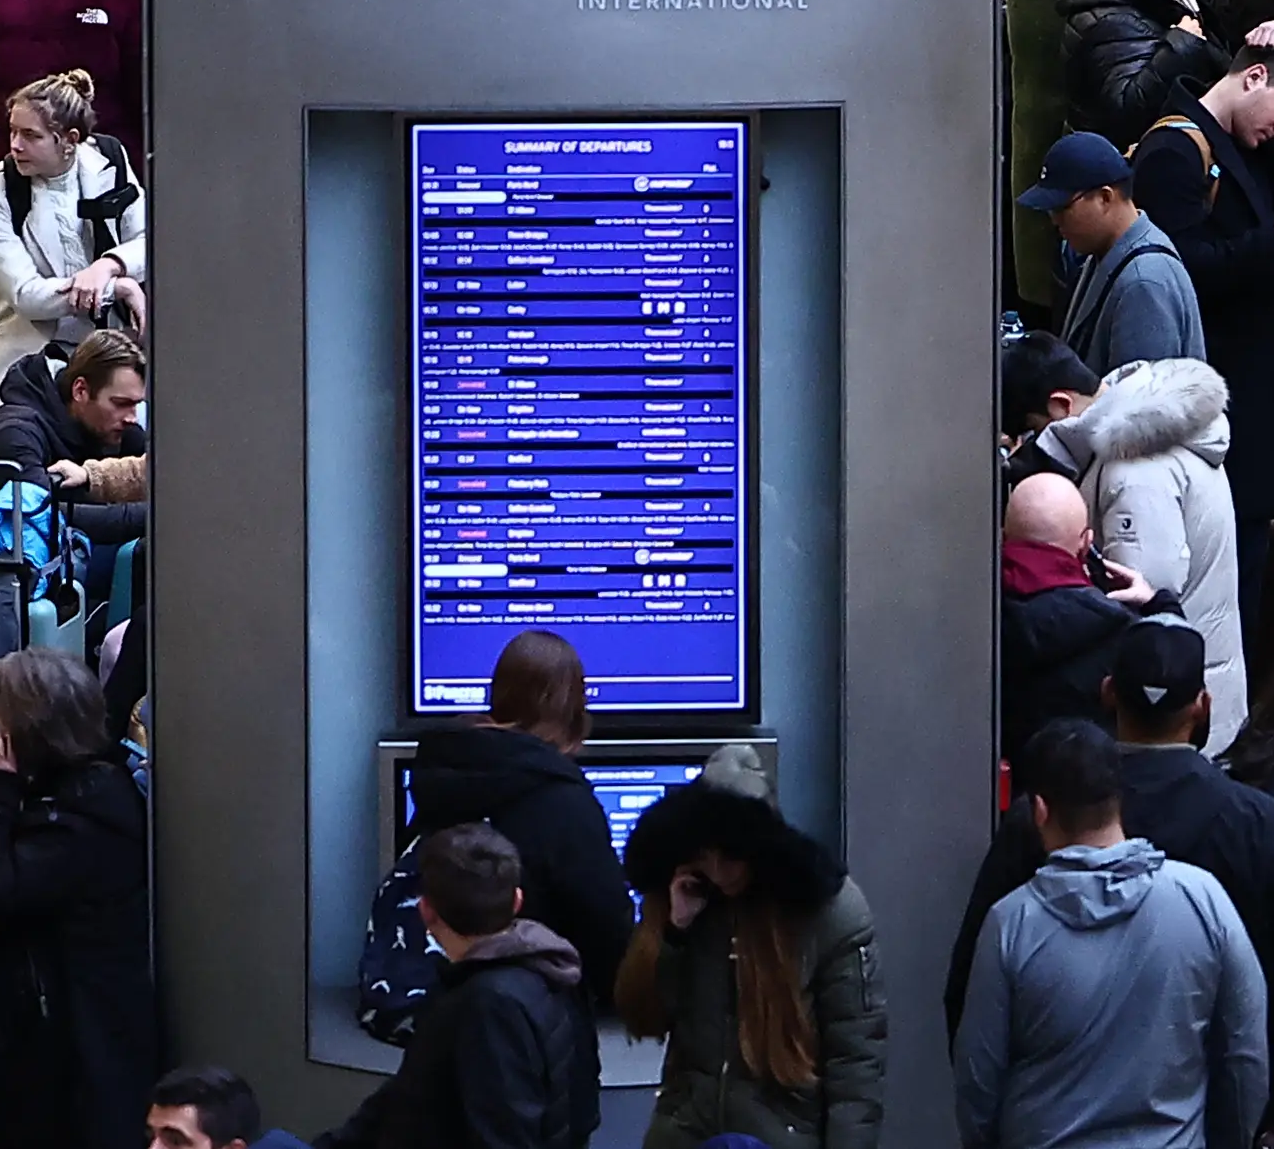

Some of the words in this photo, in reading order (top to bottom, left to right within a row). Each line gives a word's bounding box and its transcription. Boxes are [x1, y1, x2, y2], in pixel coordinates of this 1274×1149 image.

[504, 140, 561, 154] SUMMARY
[562, 140, 578, 153] OF
[579, 139, 653, 154] DEPARTURES
